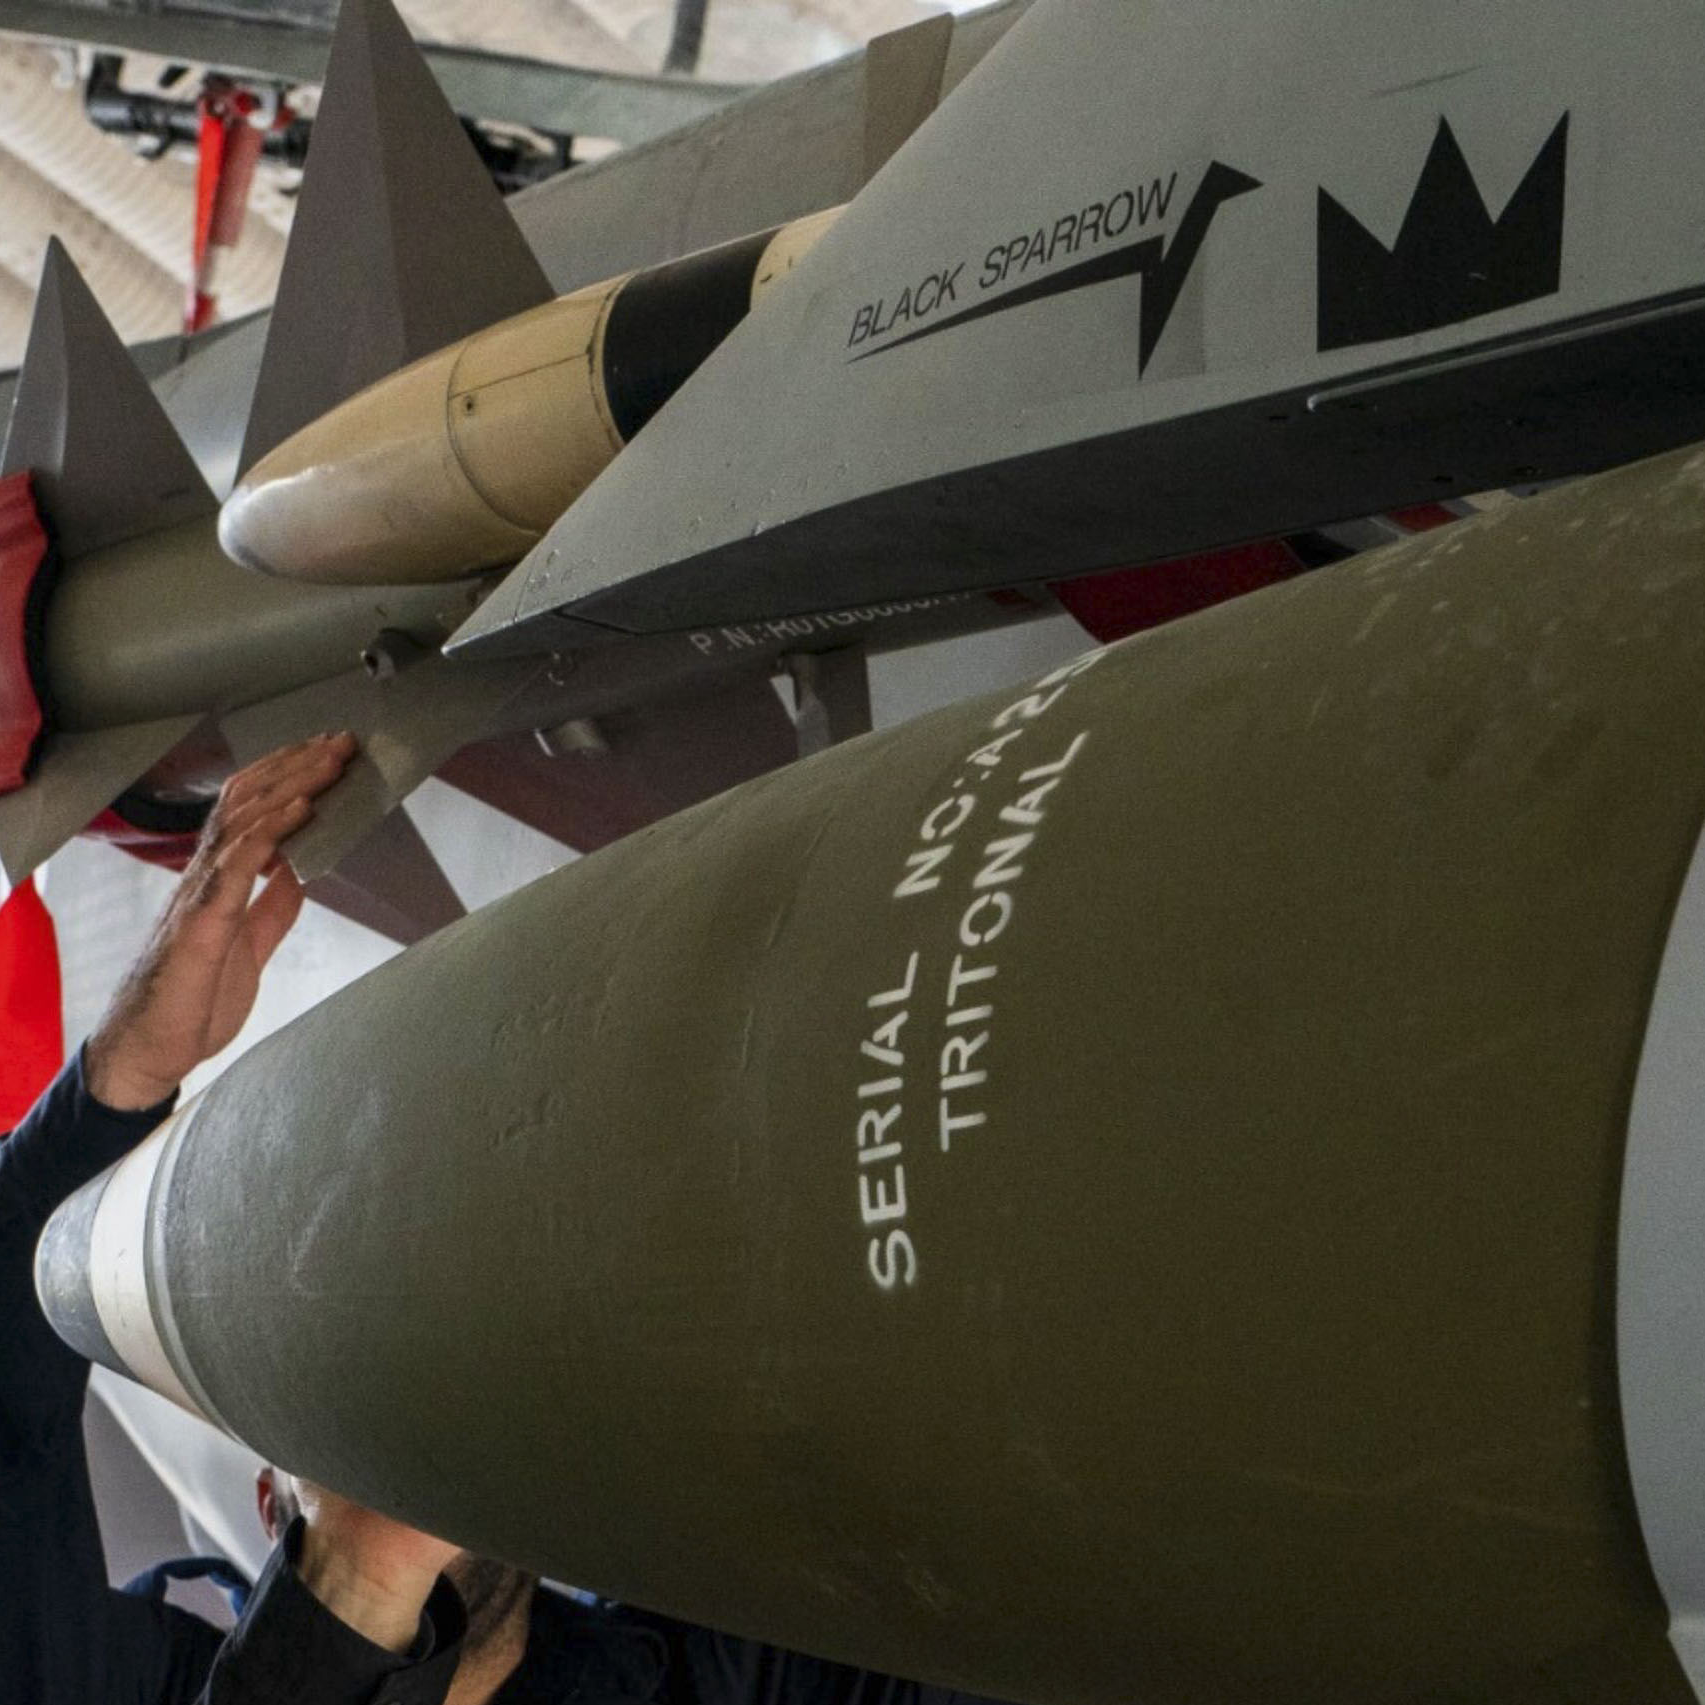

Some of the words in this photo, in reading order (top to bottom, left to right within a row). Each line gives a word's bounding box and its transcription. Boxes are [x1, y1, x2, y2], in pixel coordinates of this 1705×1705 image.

[847, 262, 966, 349] BLACK
[979, 171, 1178, 290] SPARROW
[939, 730, 1091, 1153] TRITONAL
[857, 950, 920, 1291] SERIAL
